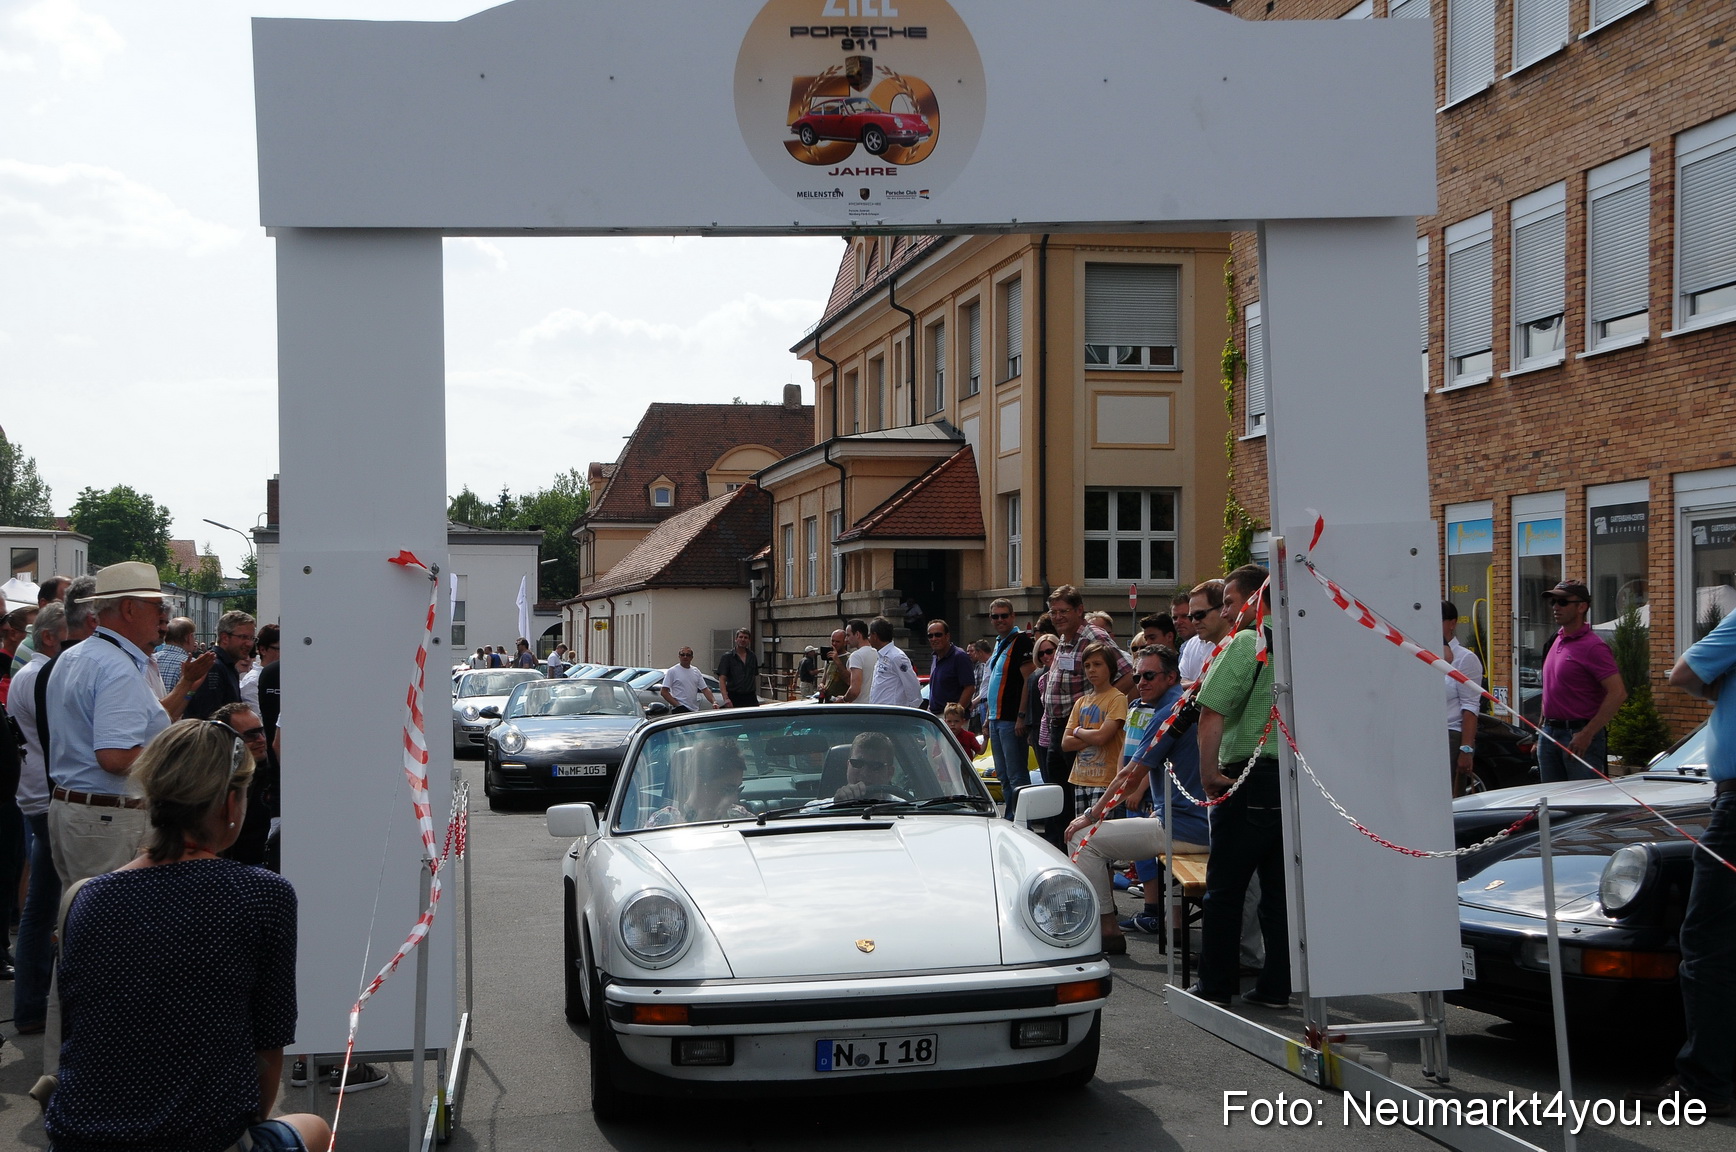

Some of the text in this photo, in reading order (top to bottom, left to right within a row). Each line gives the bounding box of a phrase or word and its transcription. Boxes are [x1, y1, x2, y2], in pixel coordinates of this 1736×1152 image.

[790, 26, 928, 38] PORSCHE
[841, 38, 877, 50] 911
[828, 167, 898, 176] JAHRE
[558, 767, 564, 775] N
[570, 766, 581, 775] MF
[583, 766, 600, 775] 105
[833, 1043, 854, 1067] N
[874, 1042, 889, 1065] I
[897, 1038, 932, 1063] 18
